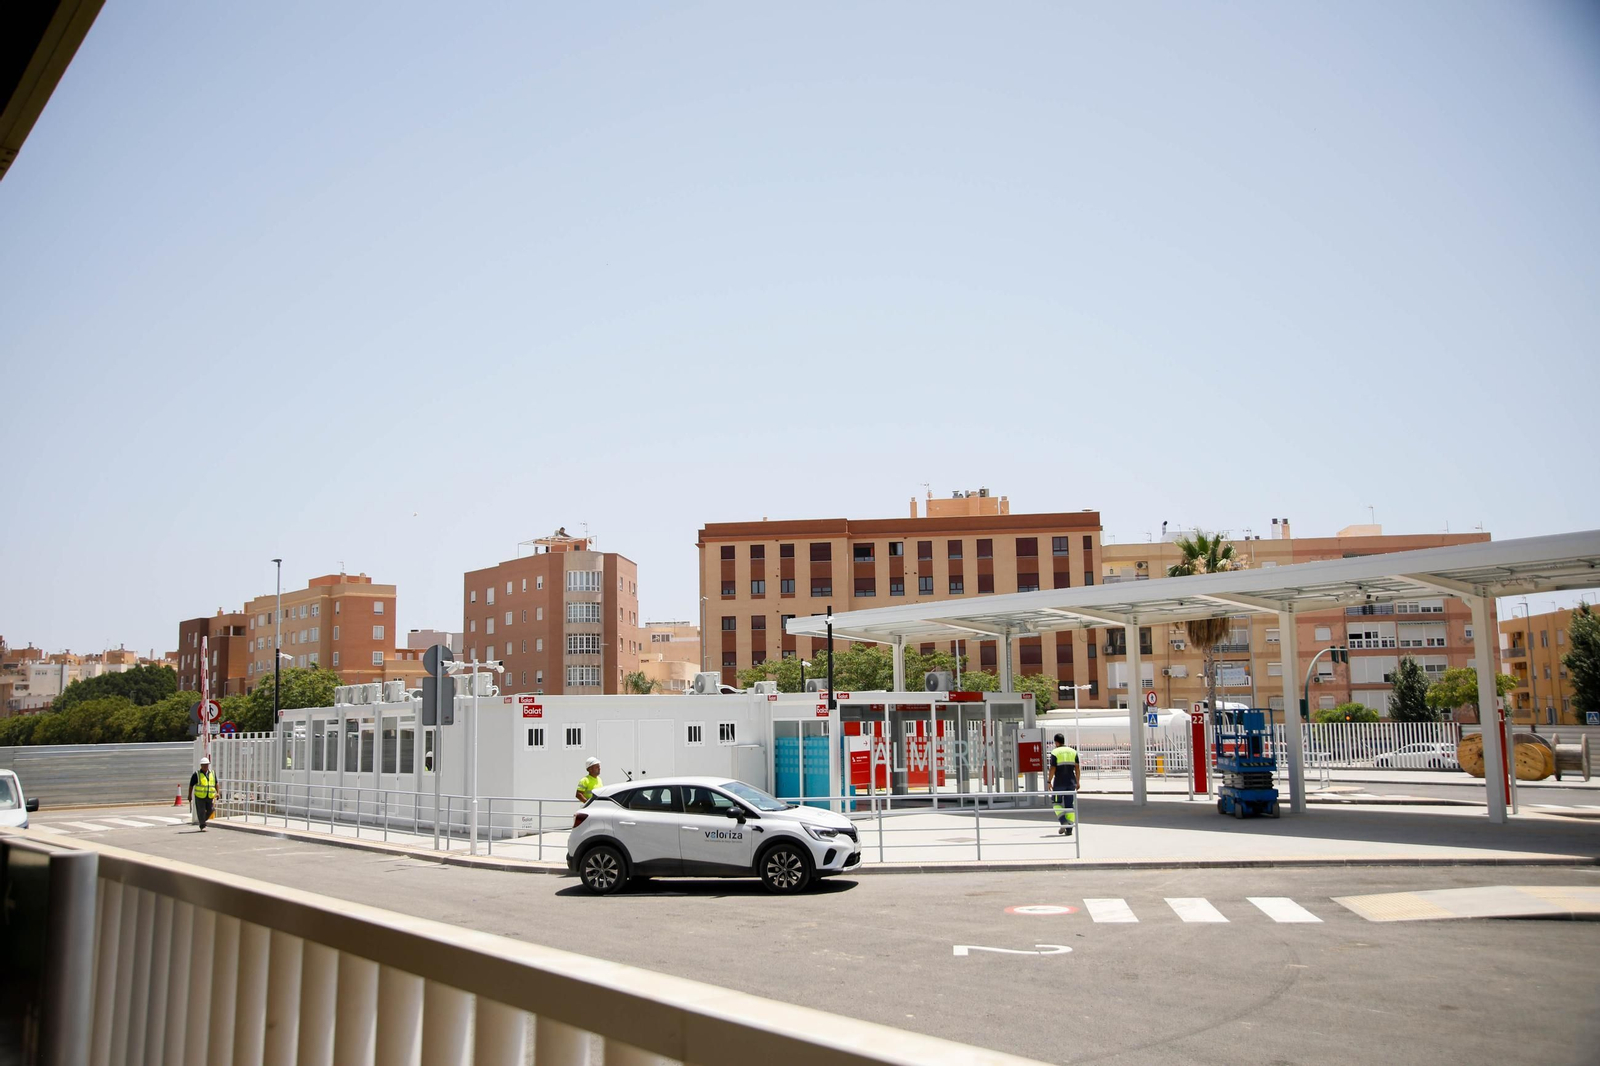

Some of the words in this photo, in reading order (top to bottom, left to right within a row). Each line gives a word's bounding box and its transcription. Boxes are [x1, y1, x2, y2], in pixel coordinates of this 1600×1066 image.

[1194, 704, 1200, 713] D
[1192, 715, 1203, 724] 22
[704, 829, 743, 840] valoriza
